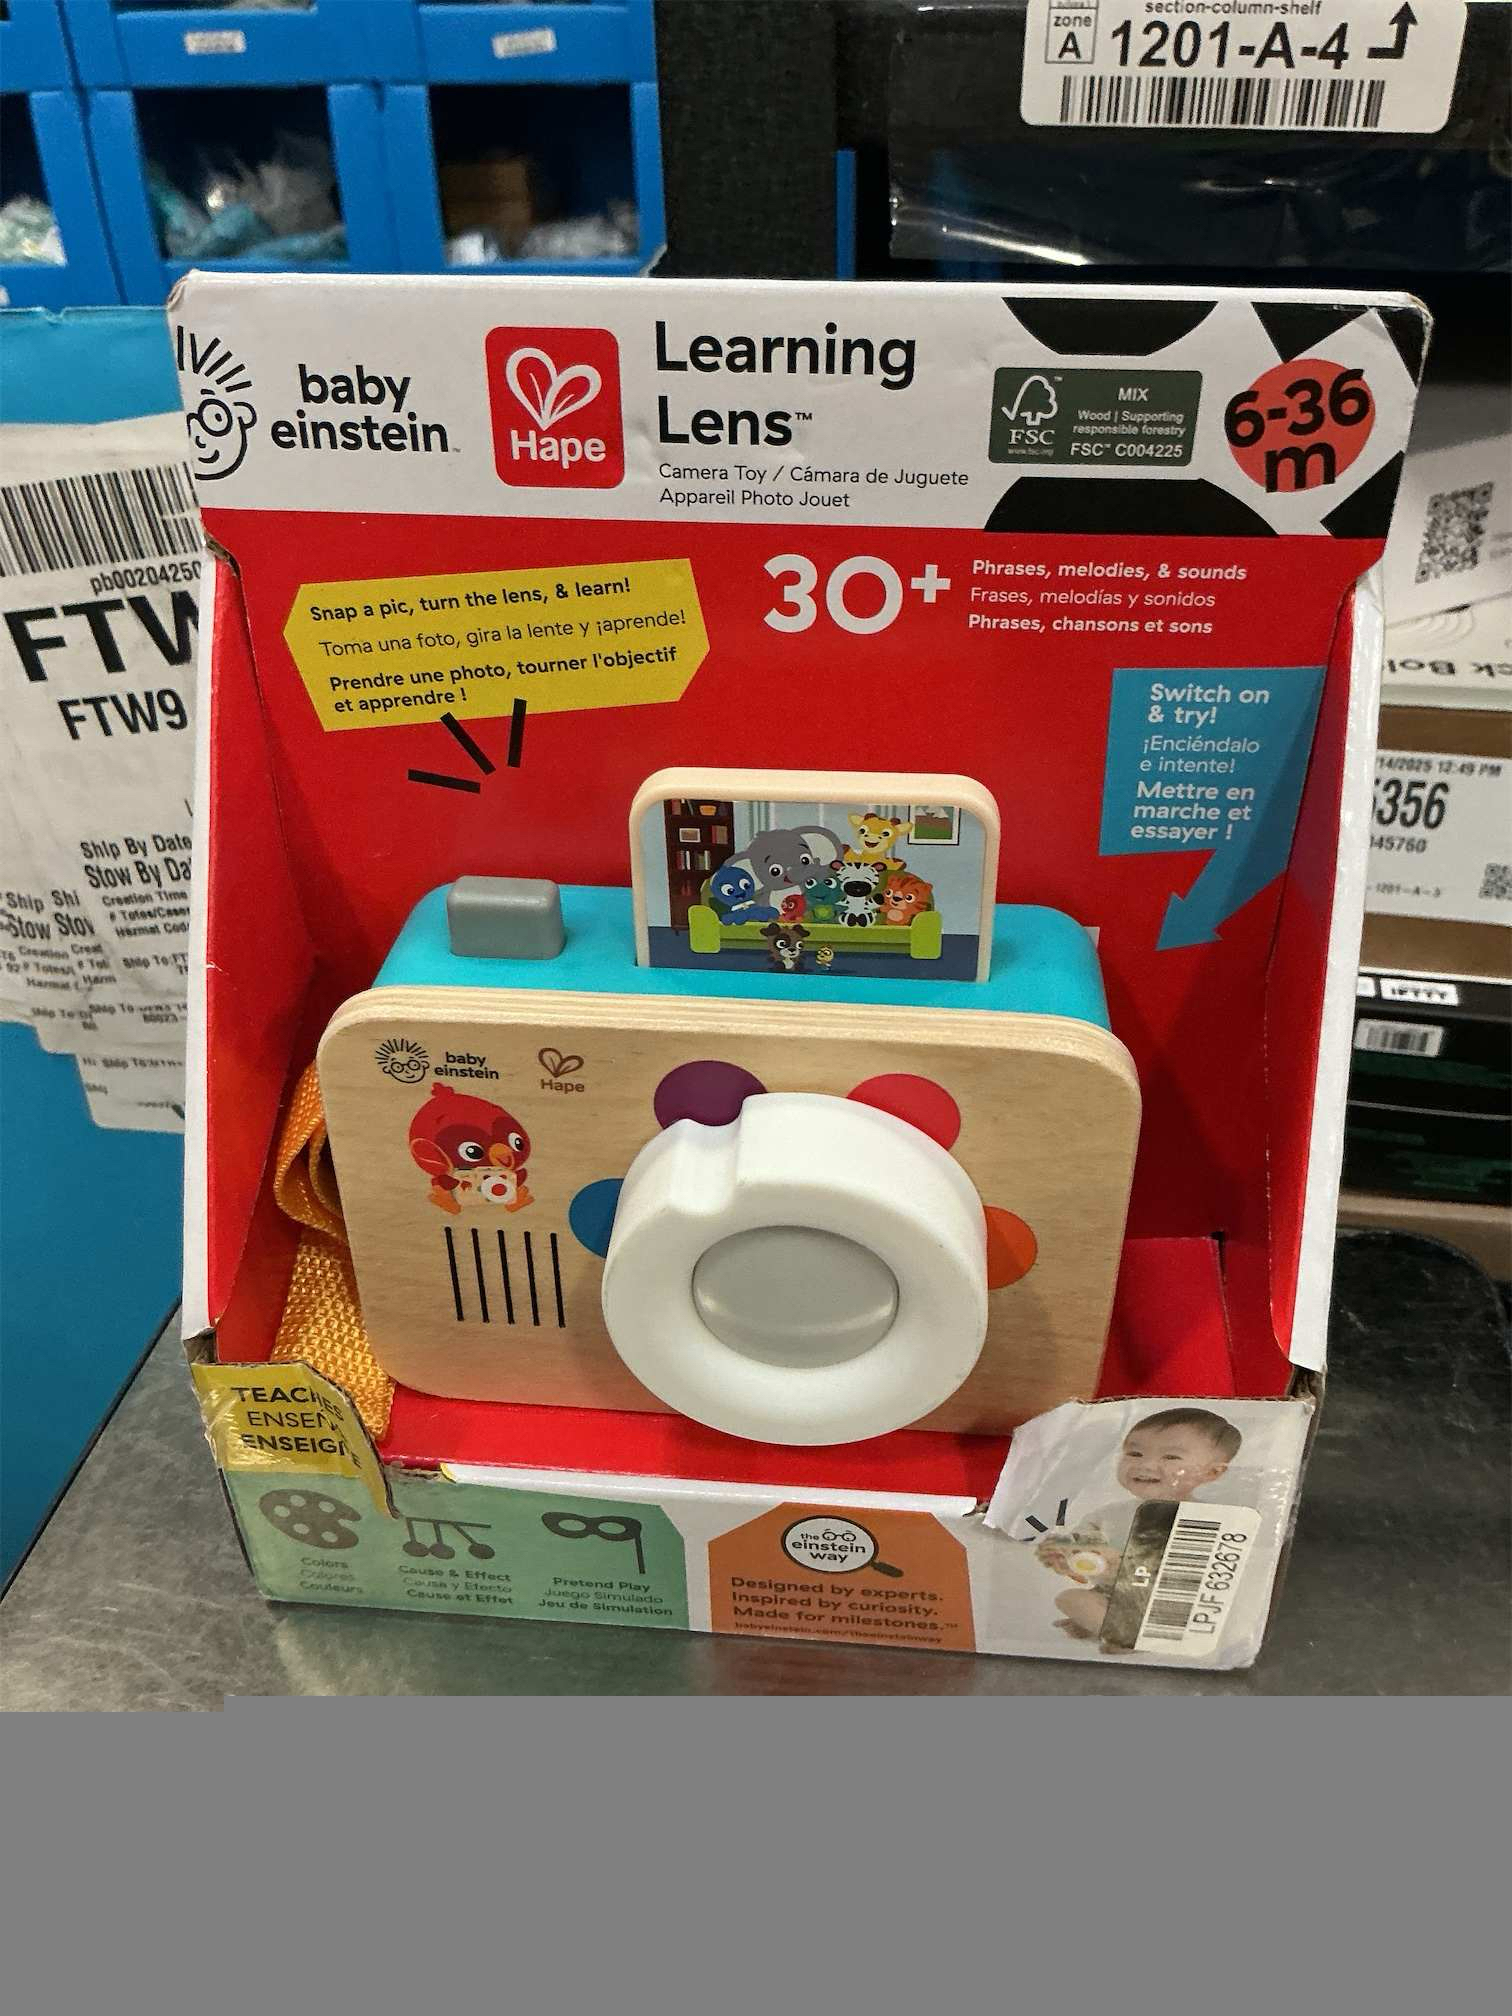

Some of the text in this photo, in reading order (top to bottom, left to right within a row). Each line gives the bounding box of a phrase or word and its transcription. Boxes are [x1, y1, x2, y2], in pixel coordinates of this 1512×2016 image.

[1053, 14, 1092, 28] zone
[1057, 31, 1082, 60] A
[1110, 19, 1349, 71] 1201-A-4
[655, 321, 916, 391] Learning
[298, 363, 411, 413] baby
[1117, 387, 1150, 402] MIX
[1077, 409, 1112, 422] Wood
[1121, 410, 1185, 425] Supporting
[1224, 368, 1371, 448] 6-36
[270, 408, 449, 453] einstein
[1008, 429, 1056, 446] FSC
[1072, 424, 1187, 438] responsible forestry
[509, 429, 607, 470] Hape
[1115, 443, 1184, 458] C004225
[658, 463, 969, 489] Camera Toy / Cámara de Juguete
[1264, 442, 1337, 494] m
[659, 488, 851, 508] Appareil Photo Jouet
[972, 559, 1248, 580] Phrases, melodies, & sounds
[310, 577, 631, 622] Snap a pic, turn the lens, & learn!
[763, 553, 951, 634] 30+
[970, 586, 1216, 608] Frases, melodías y sonidos
[318, 608, 687, 657] Toma una foto, gira la lente y ¡aprende!
[968, 613, 1213, 634] Phrases, chansons et sons
[329, 645, 677, 691] Prendre une photo, tourner l'objectif
[334, 698, 354, 713] et
[359, 690, 456, 714] apprendre
[1150, 682, 1270, 704] Switch on
[57, 688, 188, 740] FTW9
[1148, 704, 1217, 729] & try!
[1143, 735, 1260, 754] ¡Enciéndalo
[1139, 756, 1236, 774] e intente!
[1136, 780, 1255, 802] Mettre en
[1133, 803, 1252, 821] marche et
[1373, 777, 1450, 830] 356
[1130, 823, 1219, 843] essayer
[80, 840, 120, 860] Ship
[124, 837, 148, 857] By
[84, 864, 132, 889] Stow
[134, 861, 162, 888] By
[445, 1052, 486, 1067] baby
[434, 1065, 499, 1080] einstein
[540, 1079, 585, 1094] Hape
[791, 1540, 866, 1554] einstein
[800, 1532, 819, 1541] the
[300, 1557, 349, 1569] Colors
[810, 1551, 848, 1564] way
[398, 1565, 444, 1577] Cause
[464, 1570, 512, 1582] Effect
[1132, 1566, 1151, 1588] LP
[406, 1588, 451, 1601] Cause
[552, 1577, 651, 1593] Pretend Play
[731, 1576, 944, 1602] Designed by experts.
[544, 1588, 664, 1604] Juego Simulado
[732, 1591, 938, 1617] Inspired by curiosity.
[538, 1599, 673, 1616] Jeu de Simulation
[733, 1606, 790, 1620] Made
[797, 1610, 825, 1622] for
